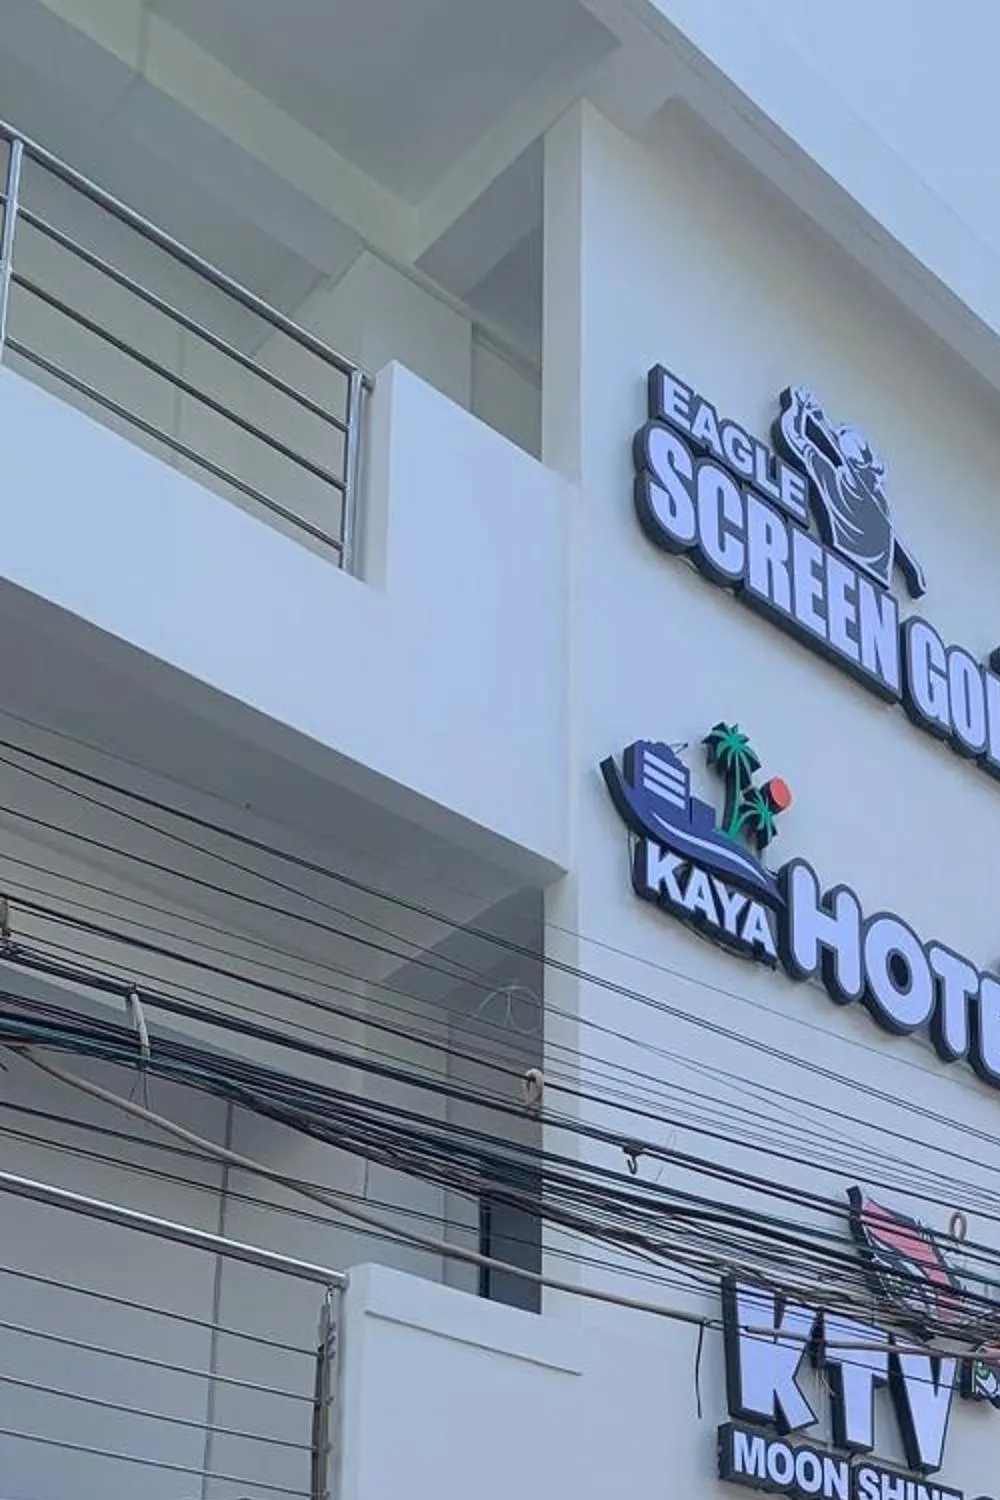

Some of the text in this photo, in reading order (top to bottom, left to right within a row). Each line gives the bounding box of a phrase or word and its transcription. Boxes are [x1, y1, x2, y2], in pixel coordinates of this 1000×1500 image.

[662, 373, 808, 521] EAGLE
[647, 425, 900, 693] SCREEN
[645, 839, 778, 956] KAYA
[735, 1279, 957, 1468] KTV
